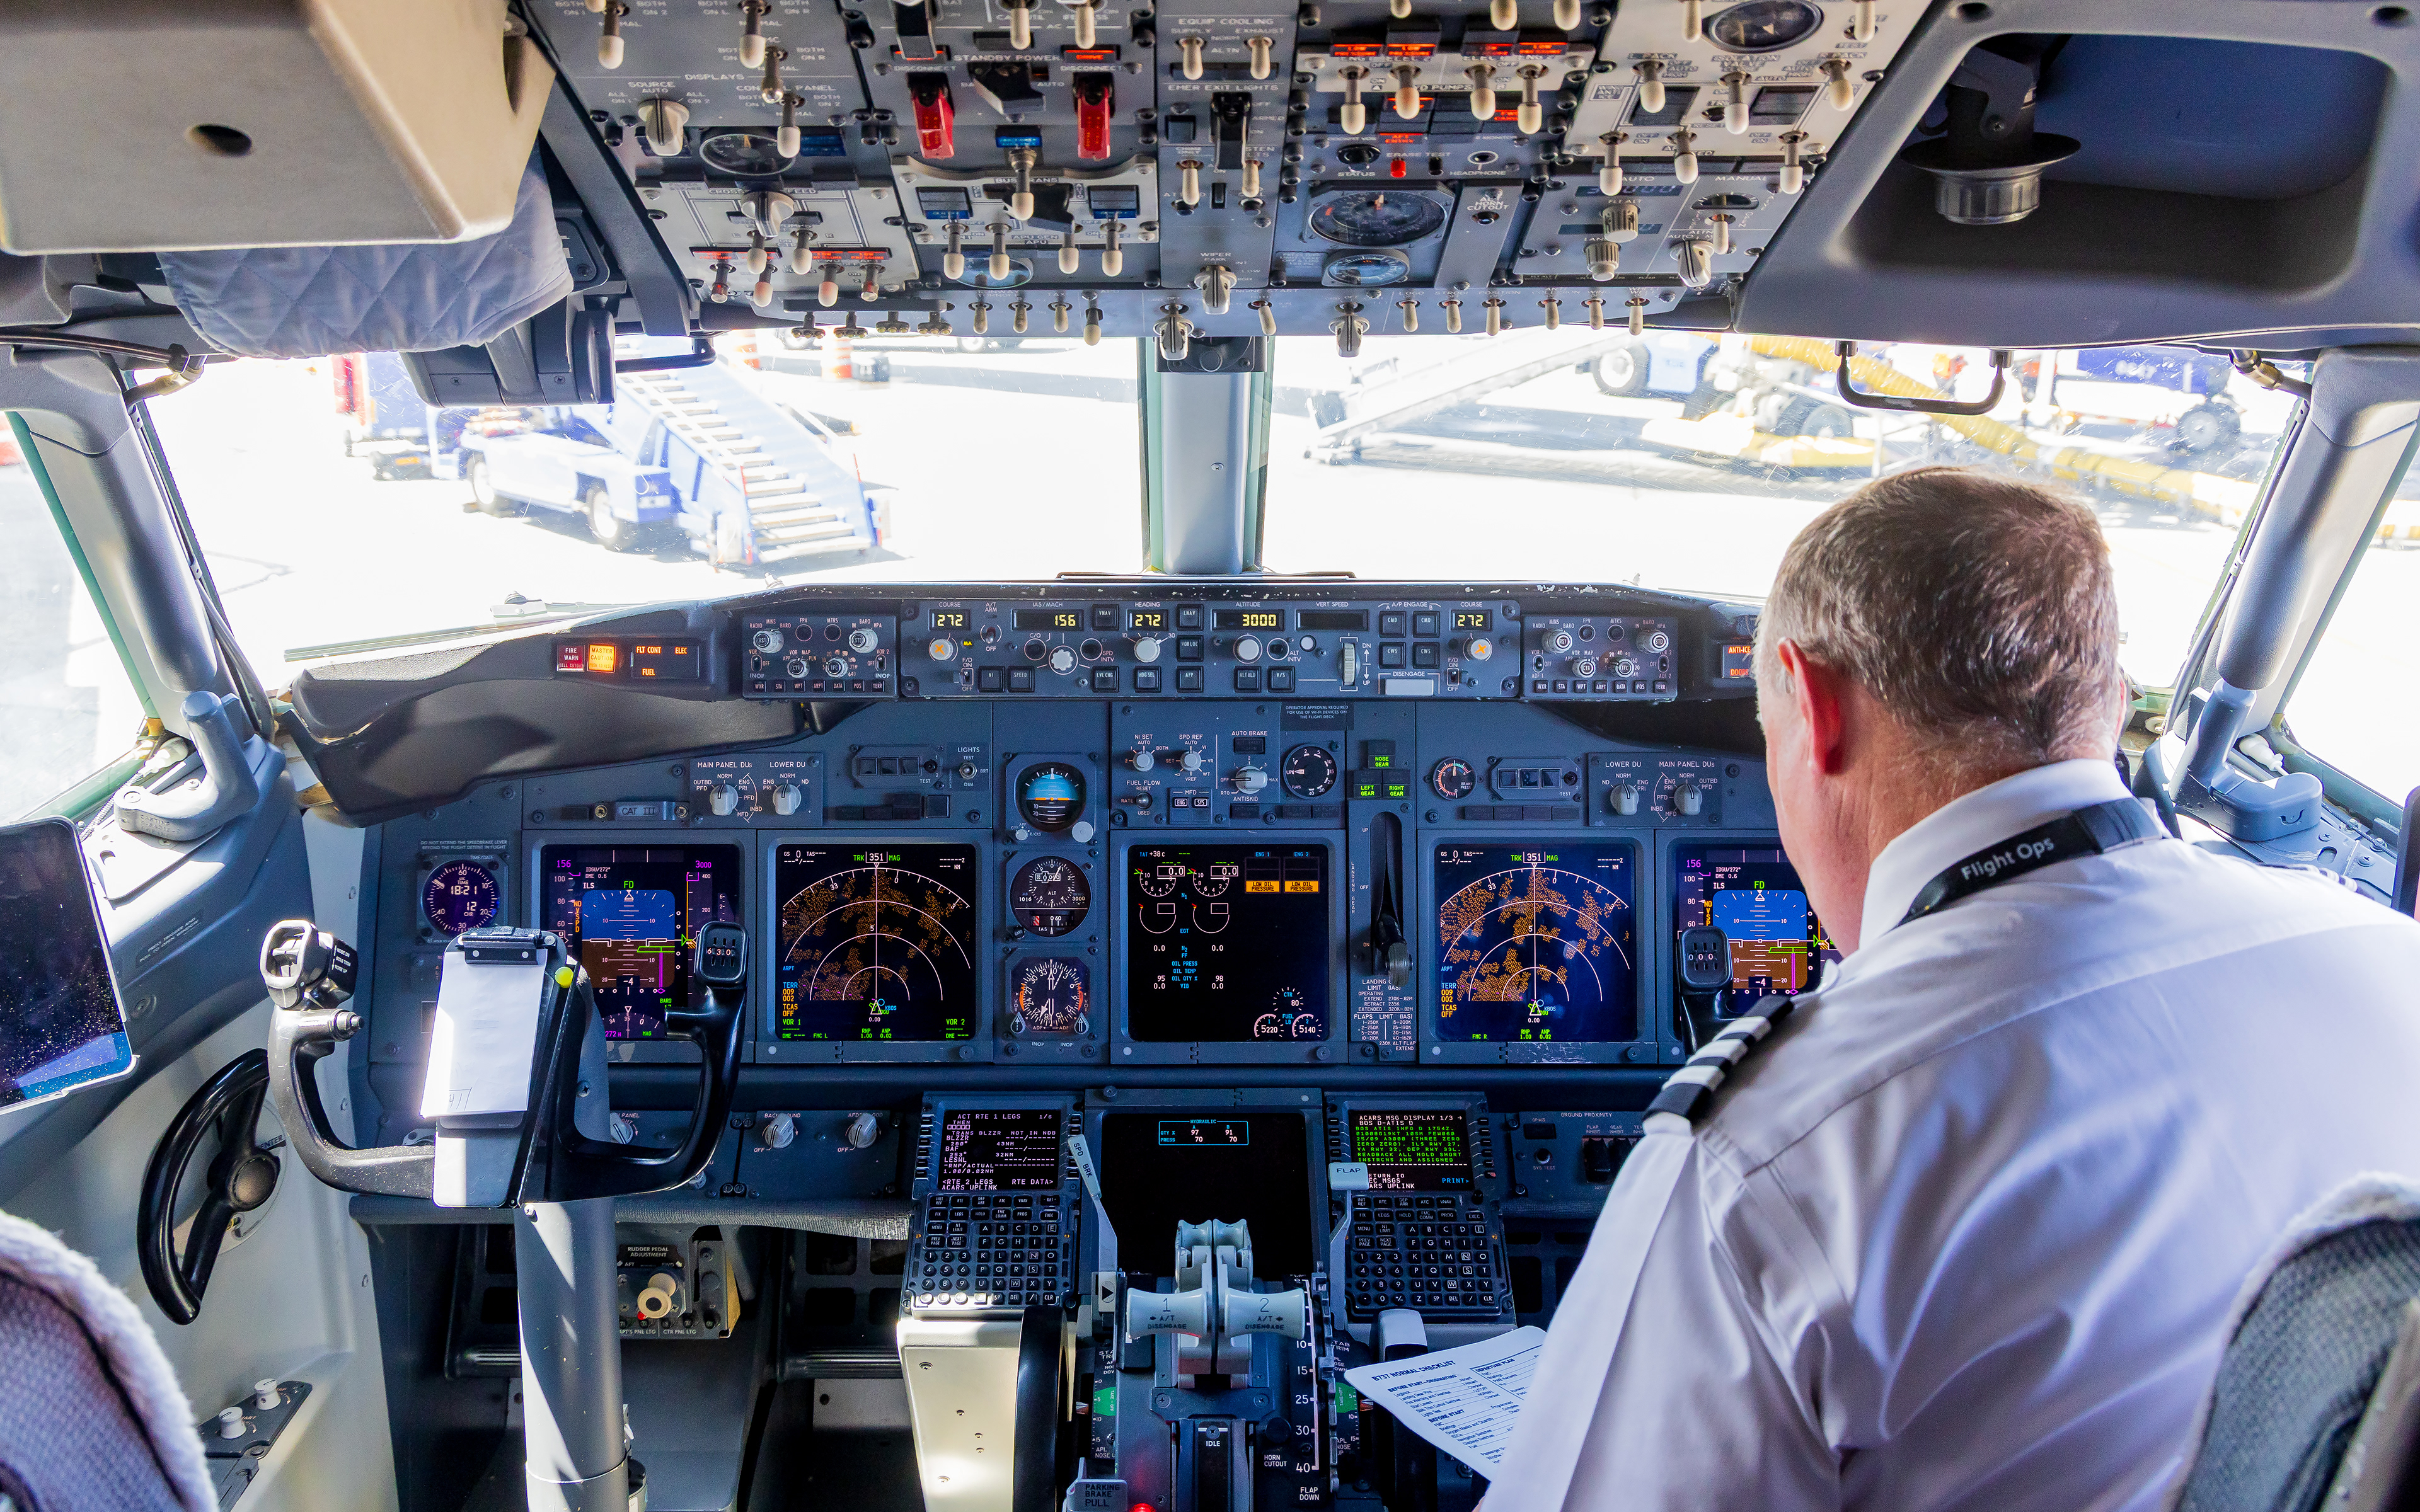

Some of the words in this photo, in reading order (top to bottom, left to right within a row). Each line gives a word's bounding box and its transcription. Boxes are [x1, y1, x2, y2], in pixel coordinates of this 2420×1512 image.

[938, 615, 962, 626] 272
[1055, 615, 1075, 626] 156
[1136, 615, 1160, 626] 272
[1243, 614, 1276, 626] 3000
[1458, 615, 1483, 626] 272
[622, 806, 638, 815] CAT
[643, 806, 655, 815] III
[1961, 851, 2015, 879] Flight
[2017, 838, 2054, 859] Ops
[451, 886, 476, 895] 18:21
[1074, 1143, 1084, 1156] SPD
[1083, 1164, 1092, 1178] BRK
[1163, 1298, 1171, 1312] 1
[1260, 1298, 1269, 1312] 2
[1372, 1373, 1390, 1382] B737
[1390, 1368, 1419, 1377] NORMAL
[1419, 1360, 1456, 1372] CHECKLIST
[1296, 1395, 1308, 1404] 25
[1296, 1426, 1309, 1435] 30
[1296, 1463, 1310, 1472] 40
